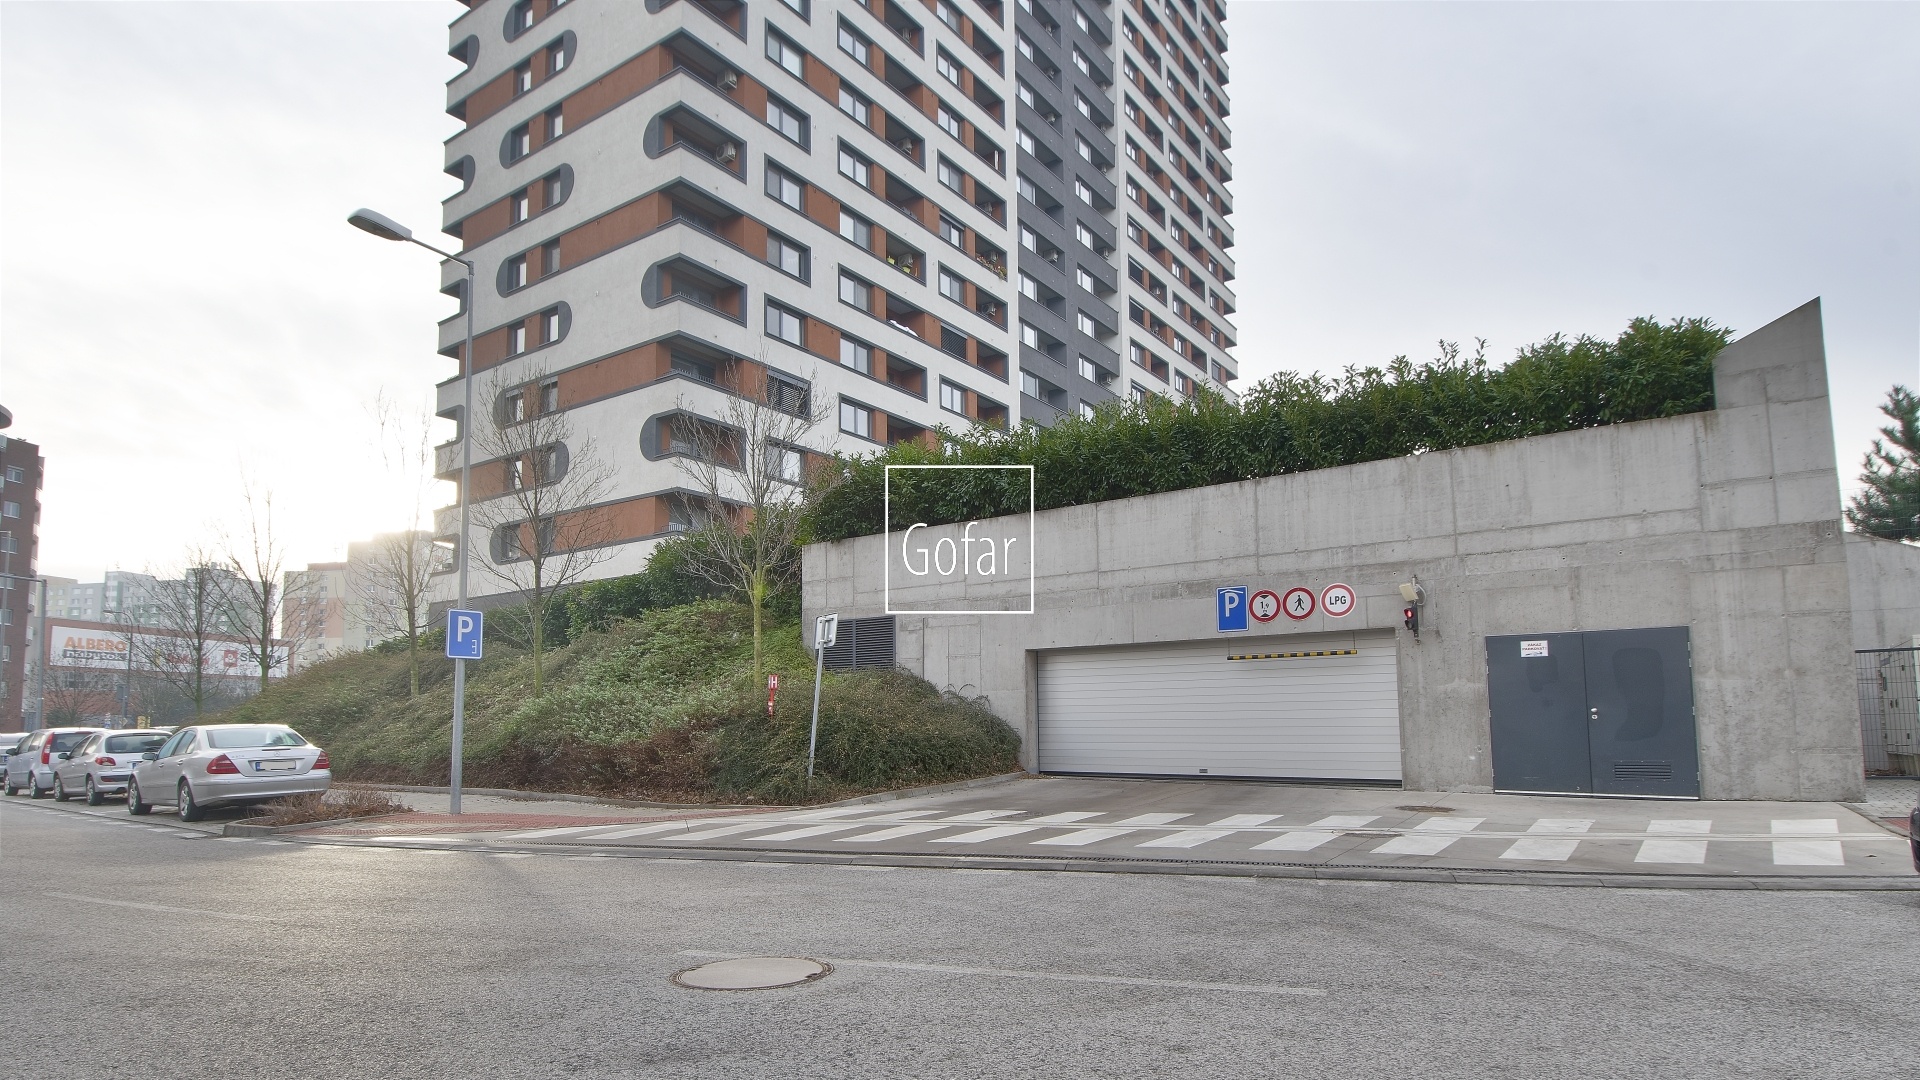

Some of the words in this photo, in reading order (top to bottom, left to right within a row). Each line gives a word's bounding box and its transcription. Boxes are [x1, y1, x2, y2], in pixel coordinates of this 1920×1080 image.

[1225, 592, 1239, 617] P
[1329, 595, 1347, 606] LPG
[457, 615, 474, 642] P
[63, 636, 127, 652] ALBERO
[771, 676, 778, 689] H
